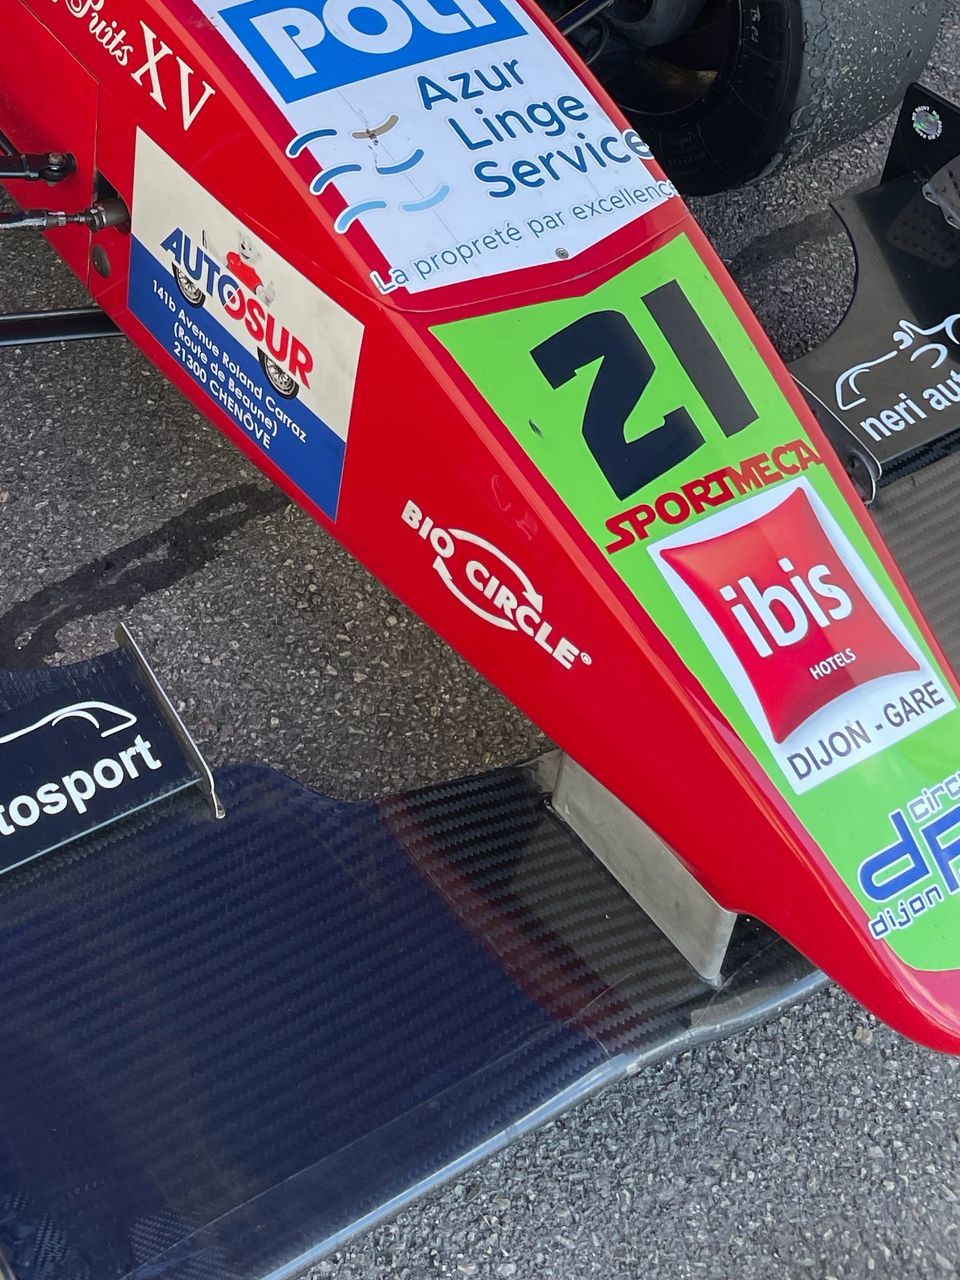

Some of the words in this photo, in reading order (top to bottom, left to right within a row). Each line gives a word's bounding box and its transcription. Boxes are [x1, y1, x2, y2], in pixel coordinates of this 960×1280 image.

[130, 19, 216, 131] XV
[417, 58, 525, 111] Azur
[447, 94, 589, 151] Linge
[473, 128, 656, 198] Service
[371, 265, 410, 293] La
[413, 222, 523, 280] propreté
[526, 210, 567, 240] par
[571, 180, 680, 221] excellence
[160, 226, 314, 391] AUTOSUR
[152, 279, 176, 314] 141b
[178, 308, 220, 357] Avenue
[222, 351, 263, 400] Roland
[265, 395, 308, 444] Carraz
[173, 321, 208, 367] (Route
[210, 360, 226, 383] de
[228, 376, 279, 438] Beaune)
[173, 341, 207, 384] 21300
[209, 381, 272, 450] CHENÔVE
[529, 278, 761, 502] 21
[859, 392, 928, 442] neri
[401, 499, 455, 559] BIO
[604, 438, 826, 555] SPORTMECA
[719, 557, 853, 658] ibis
[809, 648, 857, 680] HOTELS
[786, 720, 872, 781] DIJON
[883, 680, 945, 728] GARE
[908, 773, 960, 821] circ
[870, 885, 943, 938] dijon
